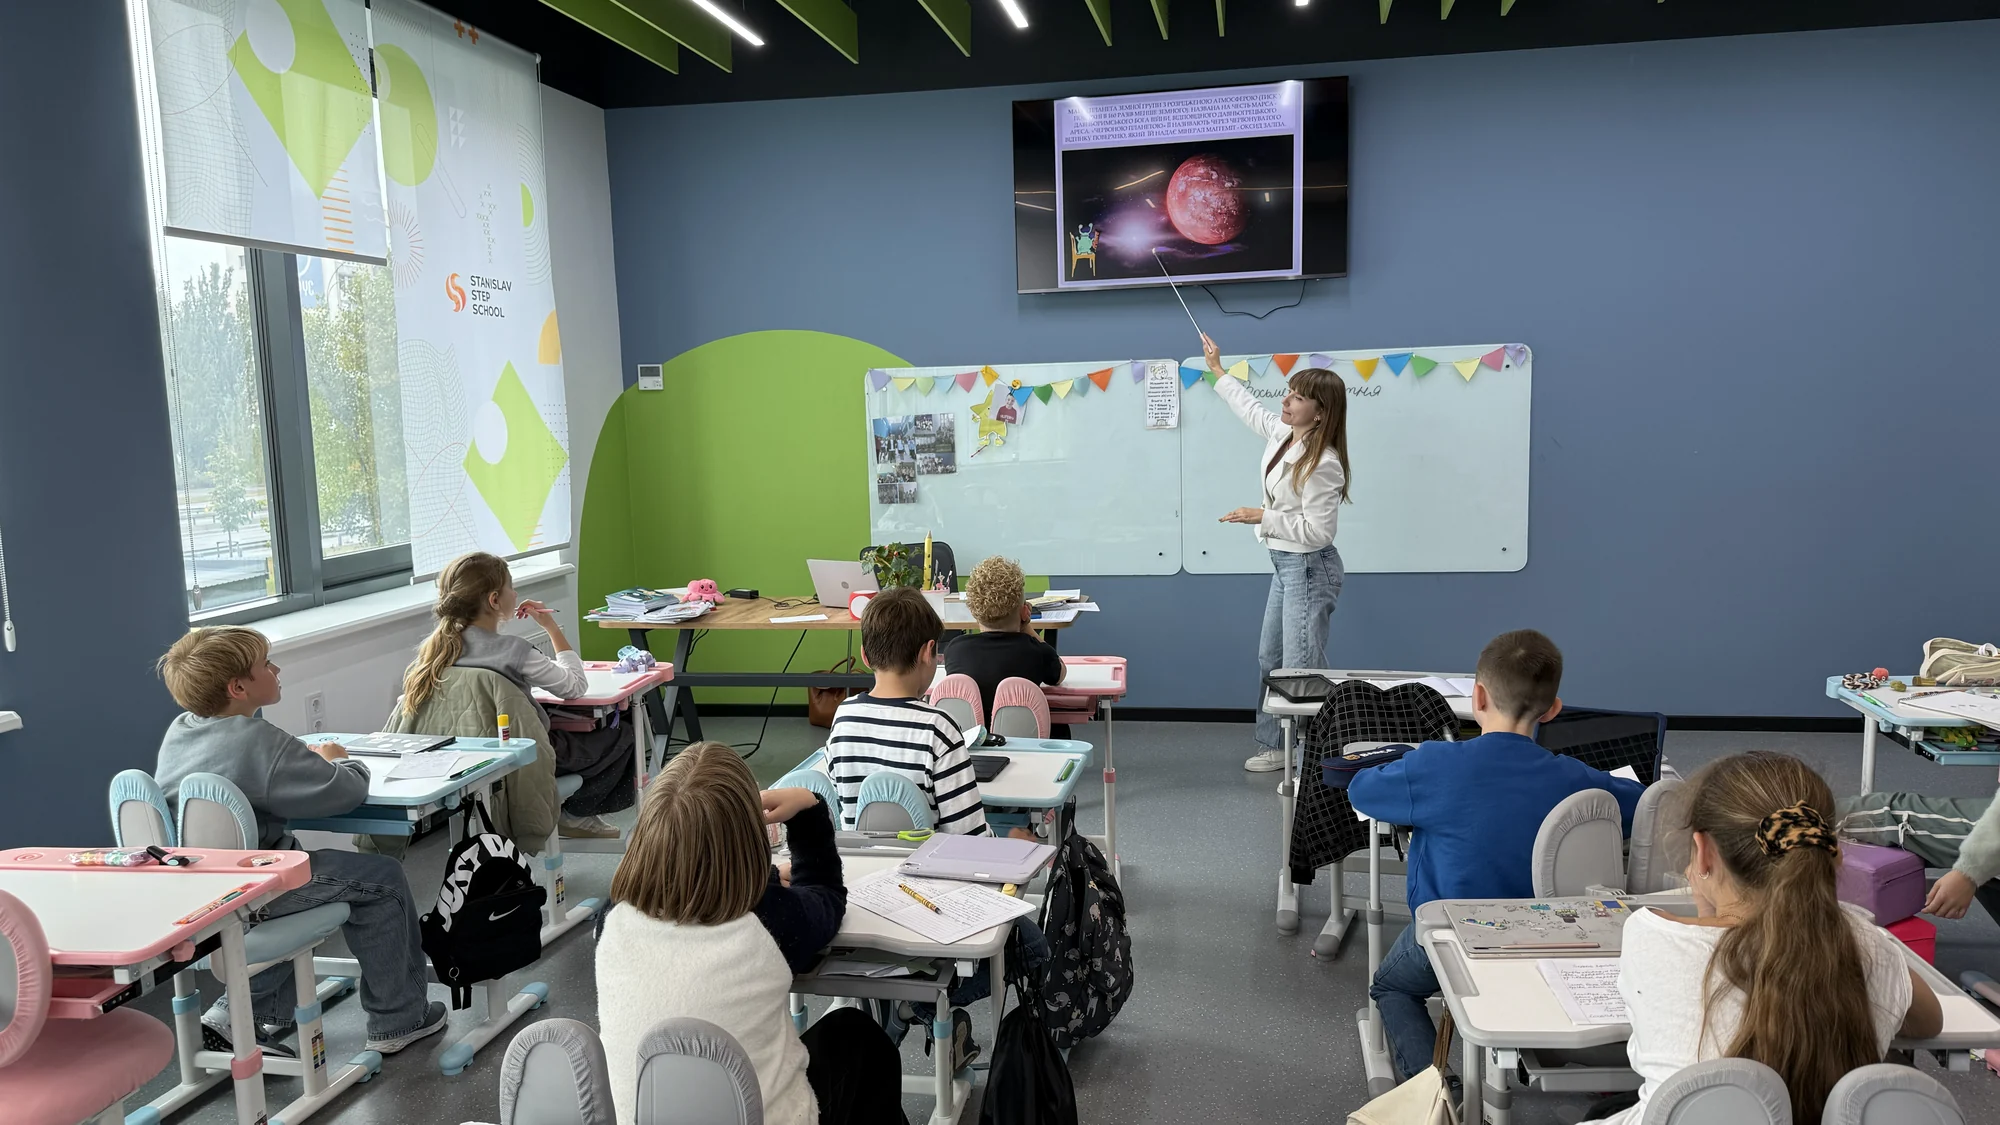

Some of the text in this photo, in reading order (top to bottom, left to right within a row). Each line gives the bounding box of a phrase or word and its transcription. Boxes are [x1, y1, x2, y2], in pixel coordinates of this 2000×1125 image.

[1213, 95, 1258, 104] АТМОСФЕРОЮ
[470, 275, 512, 292] STANISLAV
[471, 289, 491, 302] STEP
[472, 303, 505, 318] SCHOOL
[437, 843, 481, 932] JUST
[479, 834, 527, 869] DO
